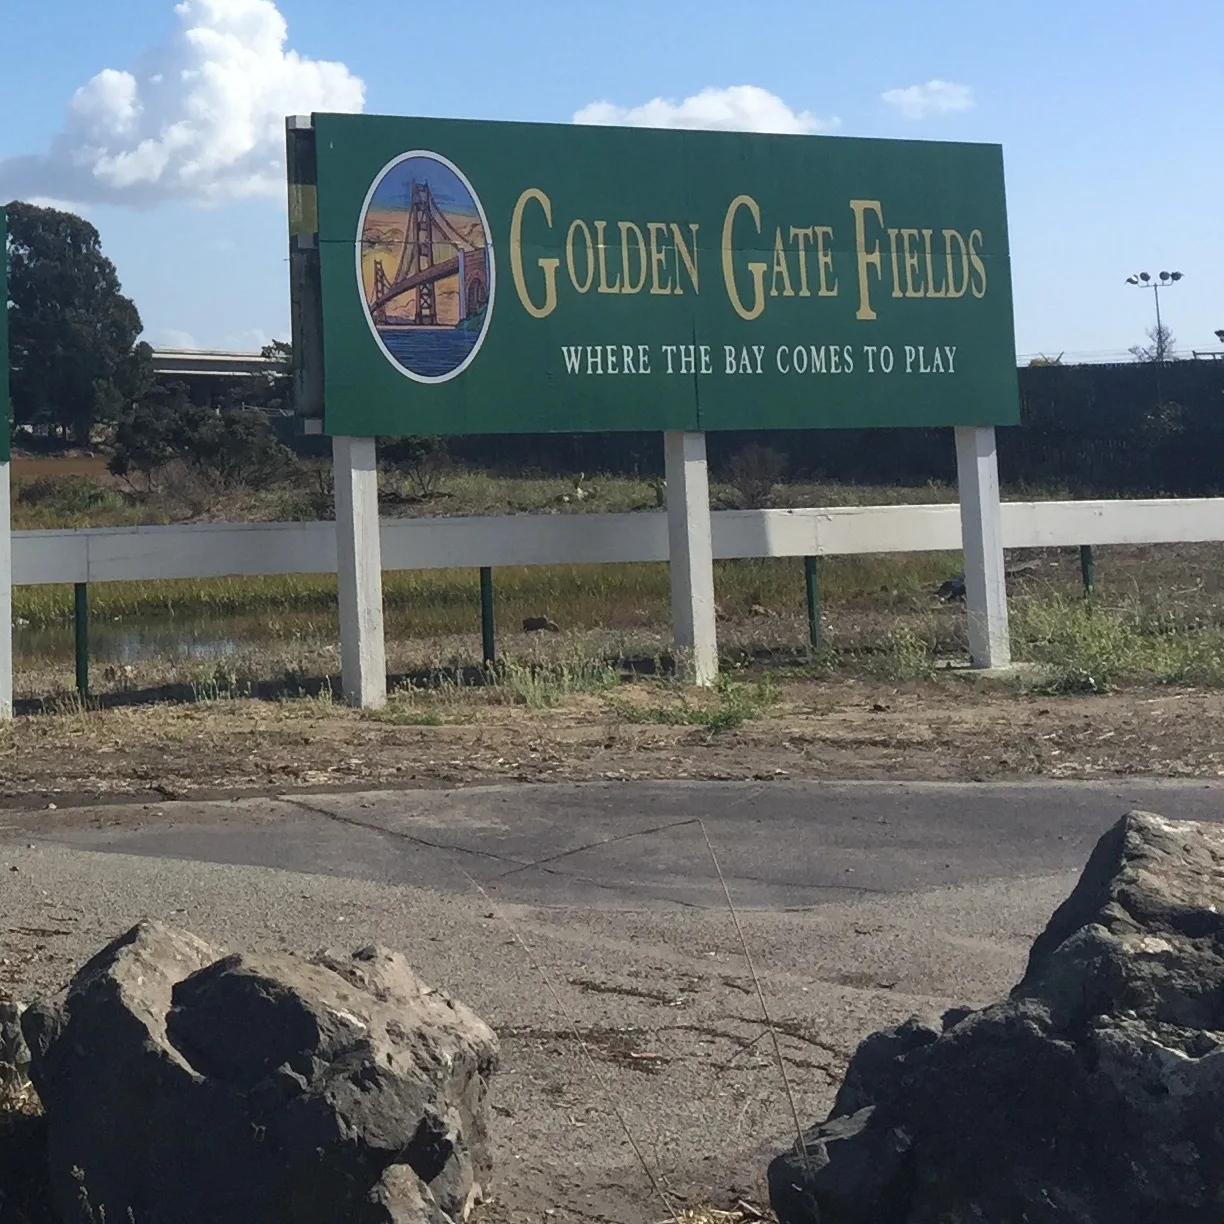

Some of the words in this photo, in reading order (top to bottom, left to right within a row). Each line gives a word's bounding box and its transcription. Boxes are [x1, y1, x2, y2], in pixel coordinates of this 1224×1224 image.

[510, 188, 700, 318] GOLDEN
[722, 194, 838, 320] GATE
[850, 199, 987, 320] FIELDS
[561, 345, 651, 374] WHERE
[662, 345, 713, 374] THE
[723, 345, 765, 374] BAY
[776, 345, 854, 373] COMES
[863, 345, 894, 373] TO
[904, 346, 957, 373] PLAY
